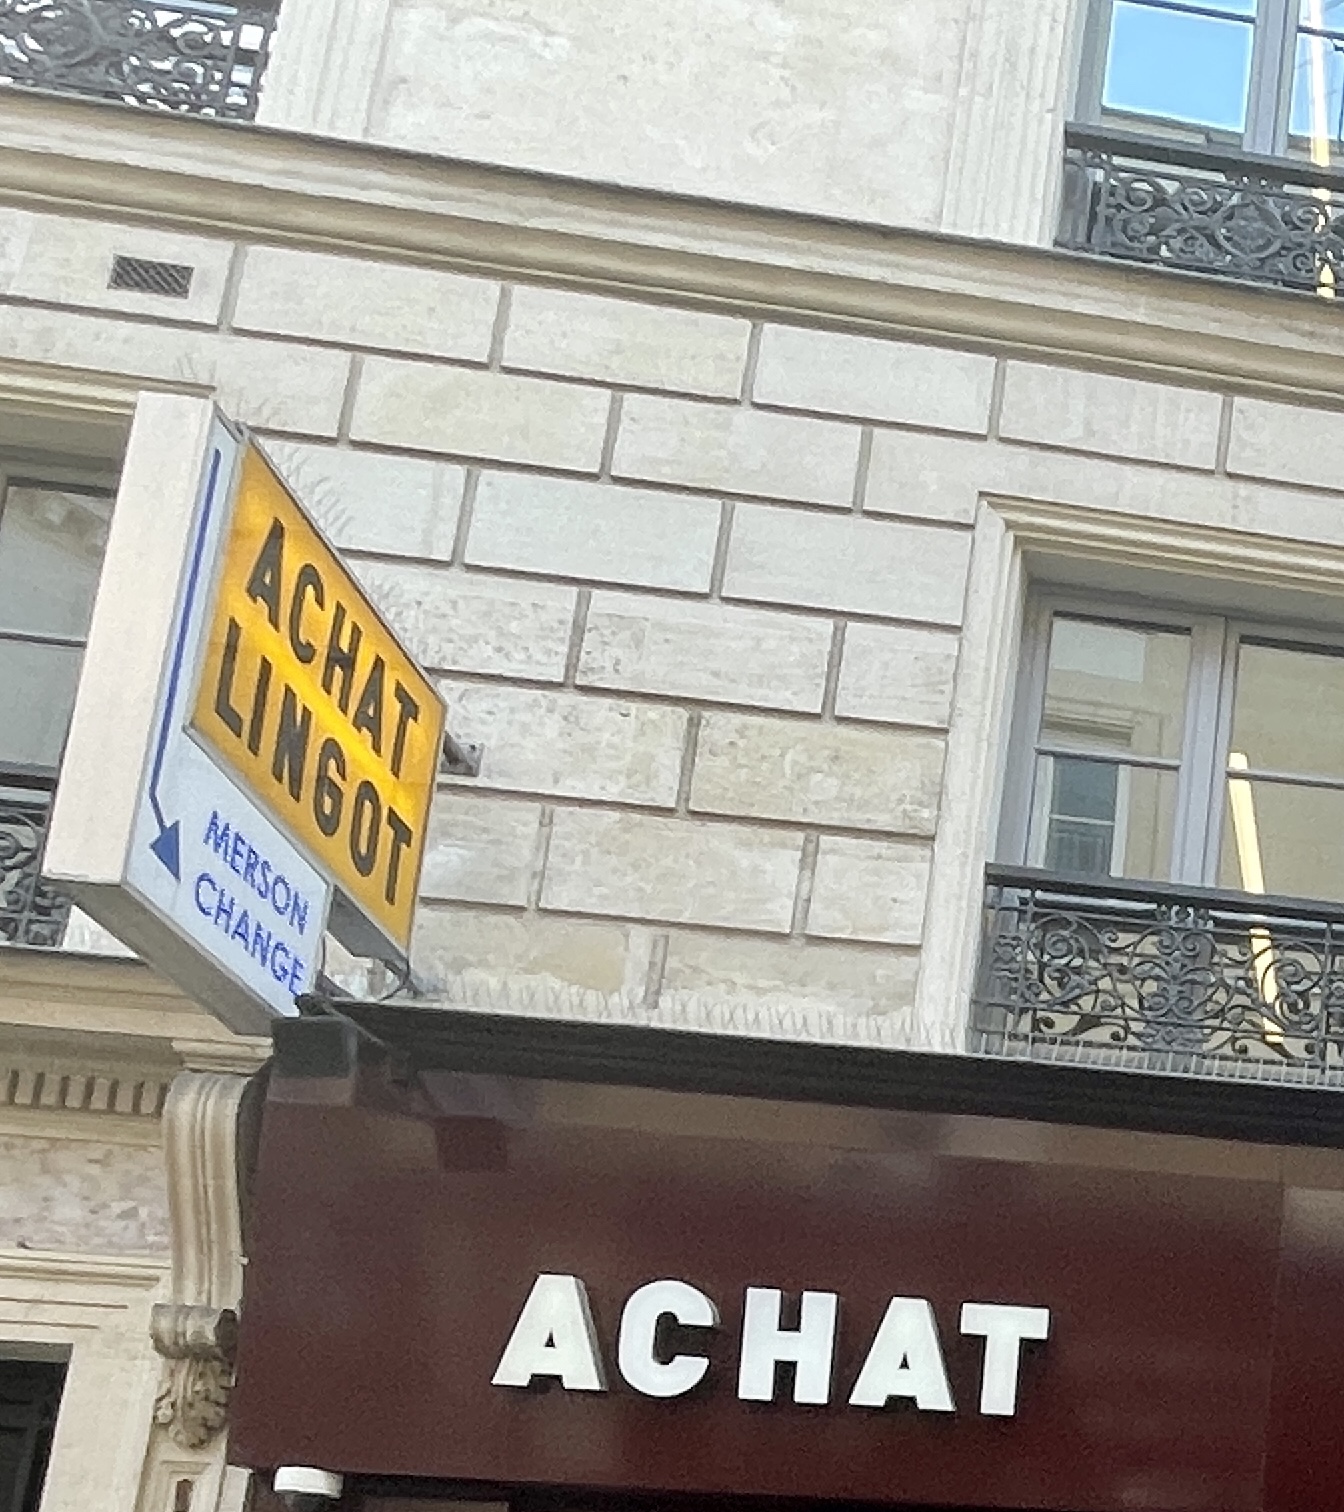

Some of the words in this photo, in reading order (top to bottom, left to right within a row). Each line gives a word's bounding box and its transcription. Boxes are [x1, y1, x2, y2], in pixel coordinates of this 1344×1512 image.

[246, 517, 420, 777] ACHAT
[213, 616, 412, 905] LINGOT
[194, 871, 303, 996] CHANGE
[202, 809, 309, 936] MERSON
[490, 1272, 1051, 1416] ACHAT
